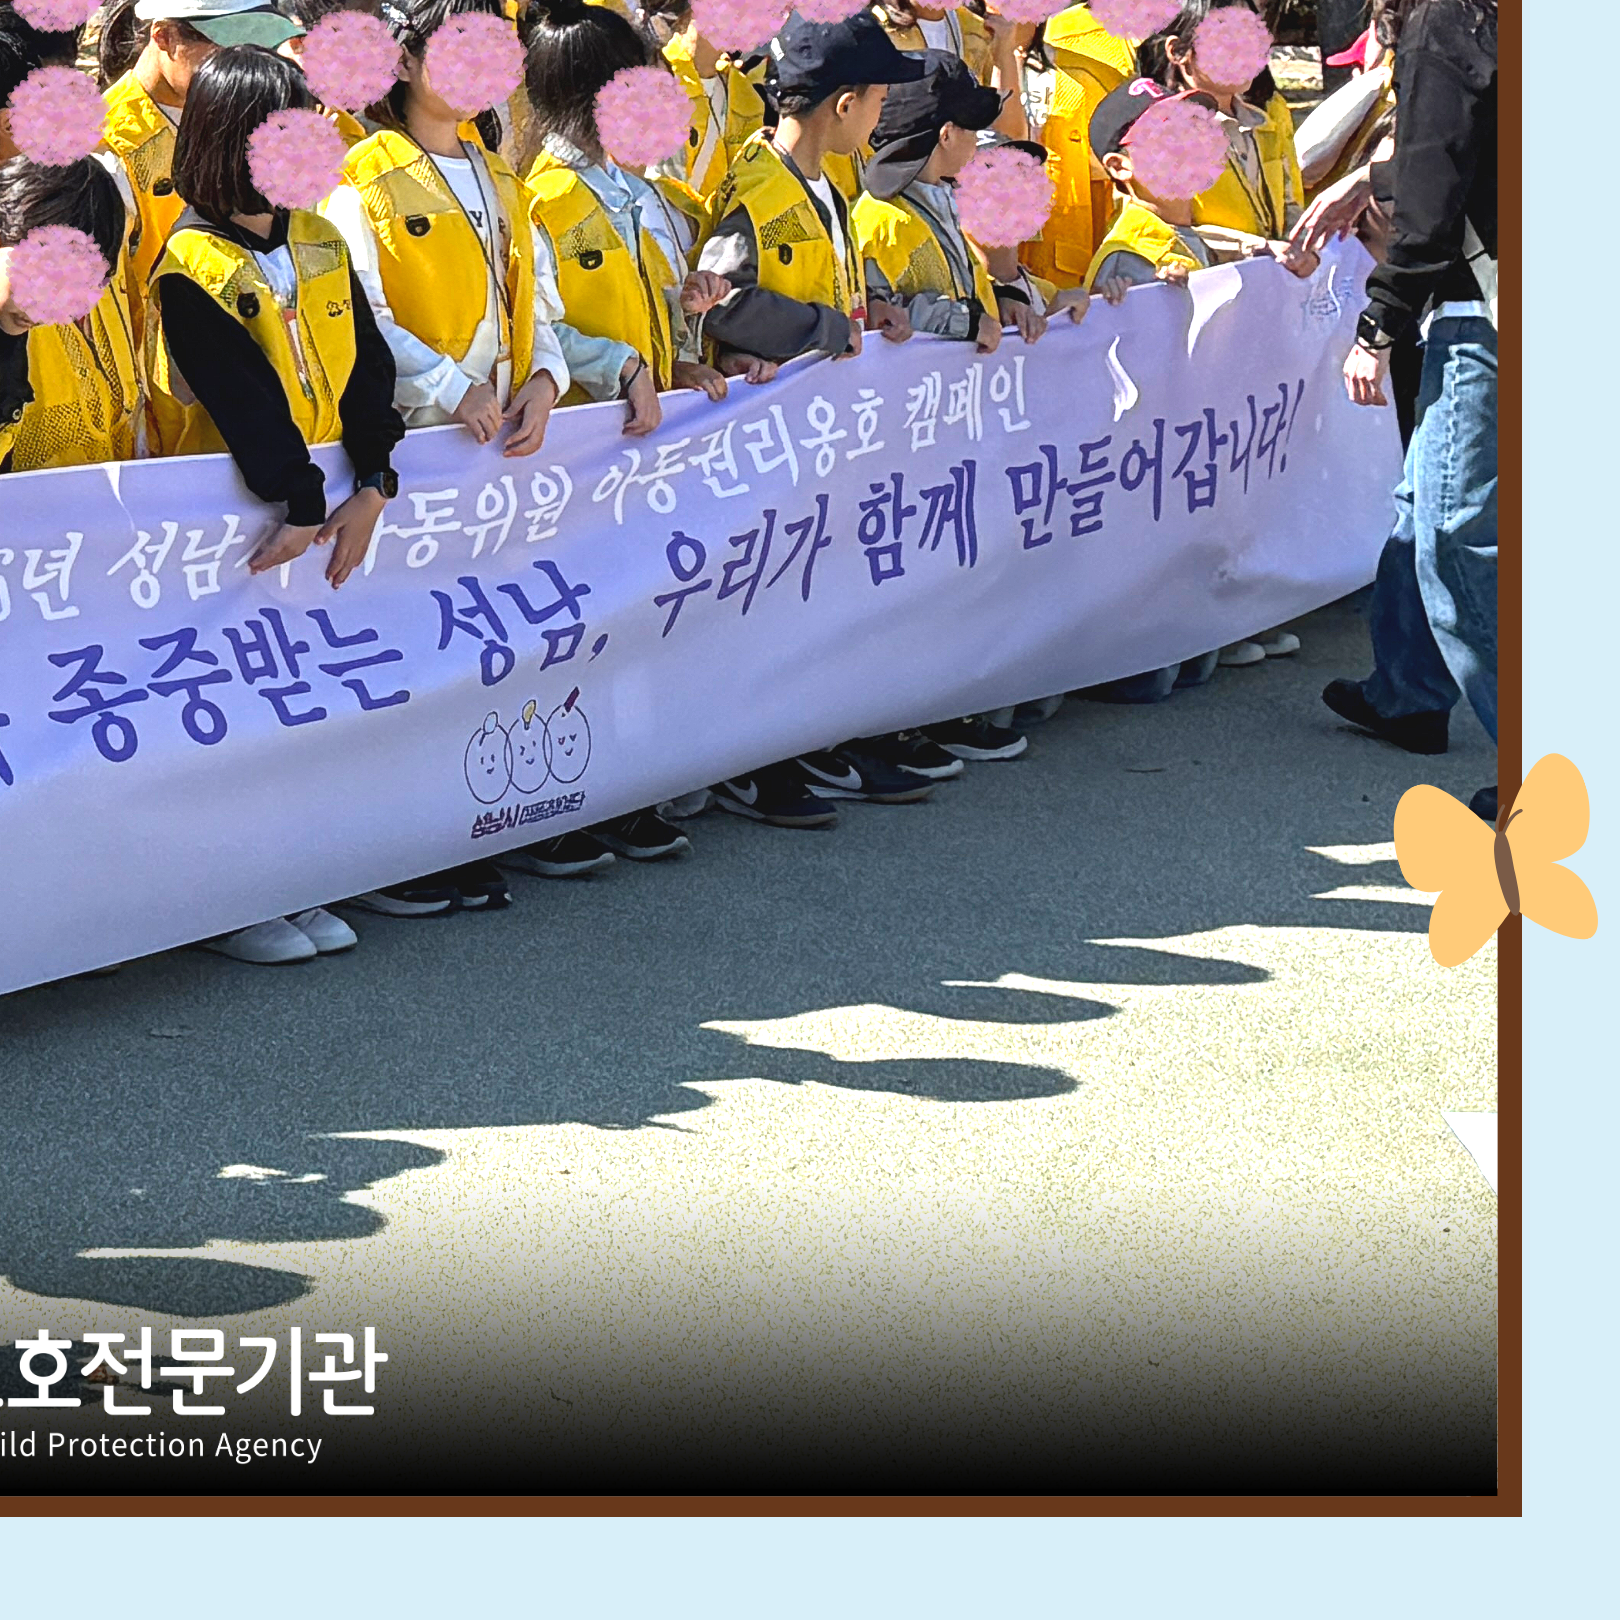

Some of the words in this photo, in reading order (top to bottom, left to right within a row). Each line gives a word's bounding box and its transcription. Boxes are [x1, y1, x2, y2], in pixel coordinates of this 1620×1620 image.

[47, 607, 411, 763] 종중받는
[429, 559, 609, 688] 성남,
[653, 493, 833, 637] 우리가
[857, 459, 978, 587] 함께
[1004, 381, 1305, 551] 만들어갑니다!
[592, 387, 885, 525] 아동권리옹호
[903, 356, 1031, 453] 캠페인
